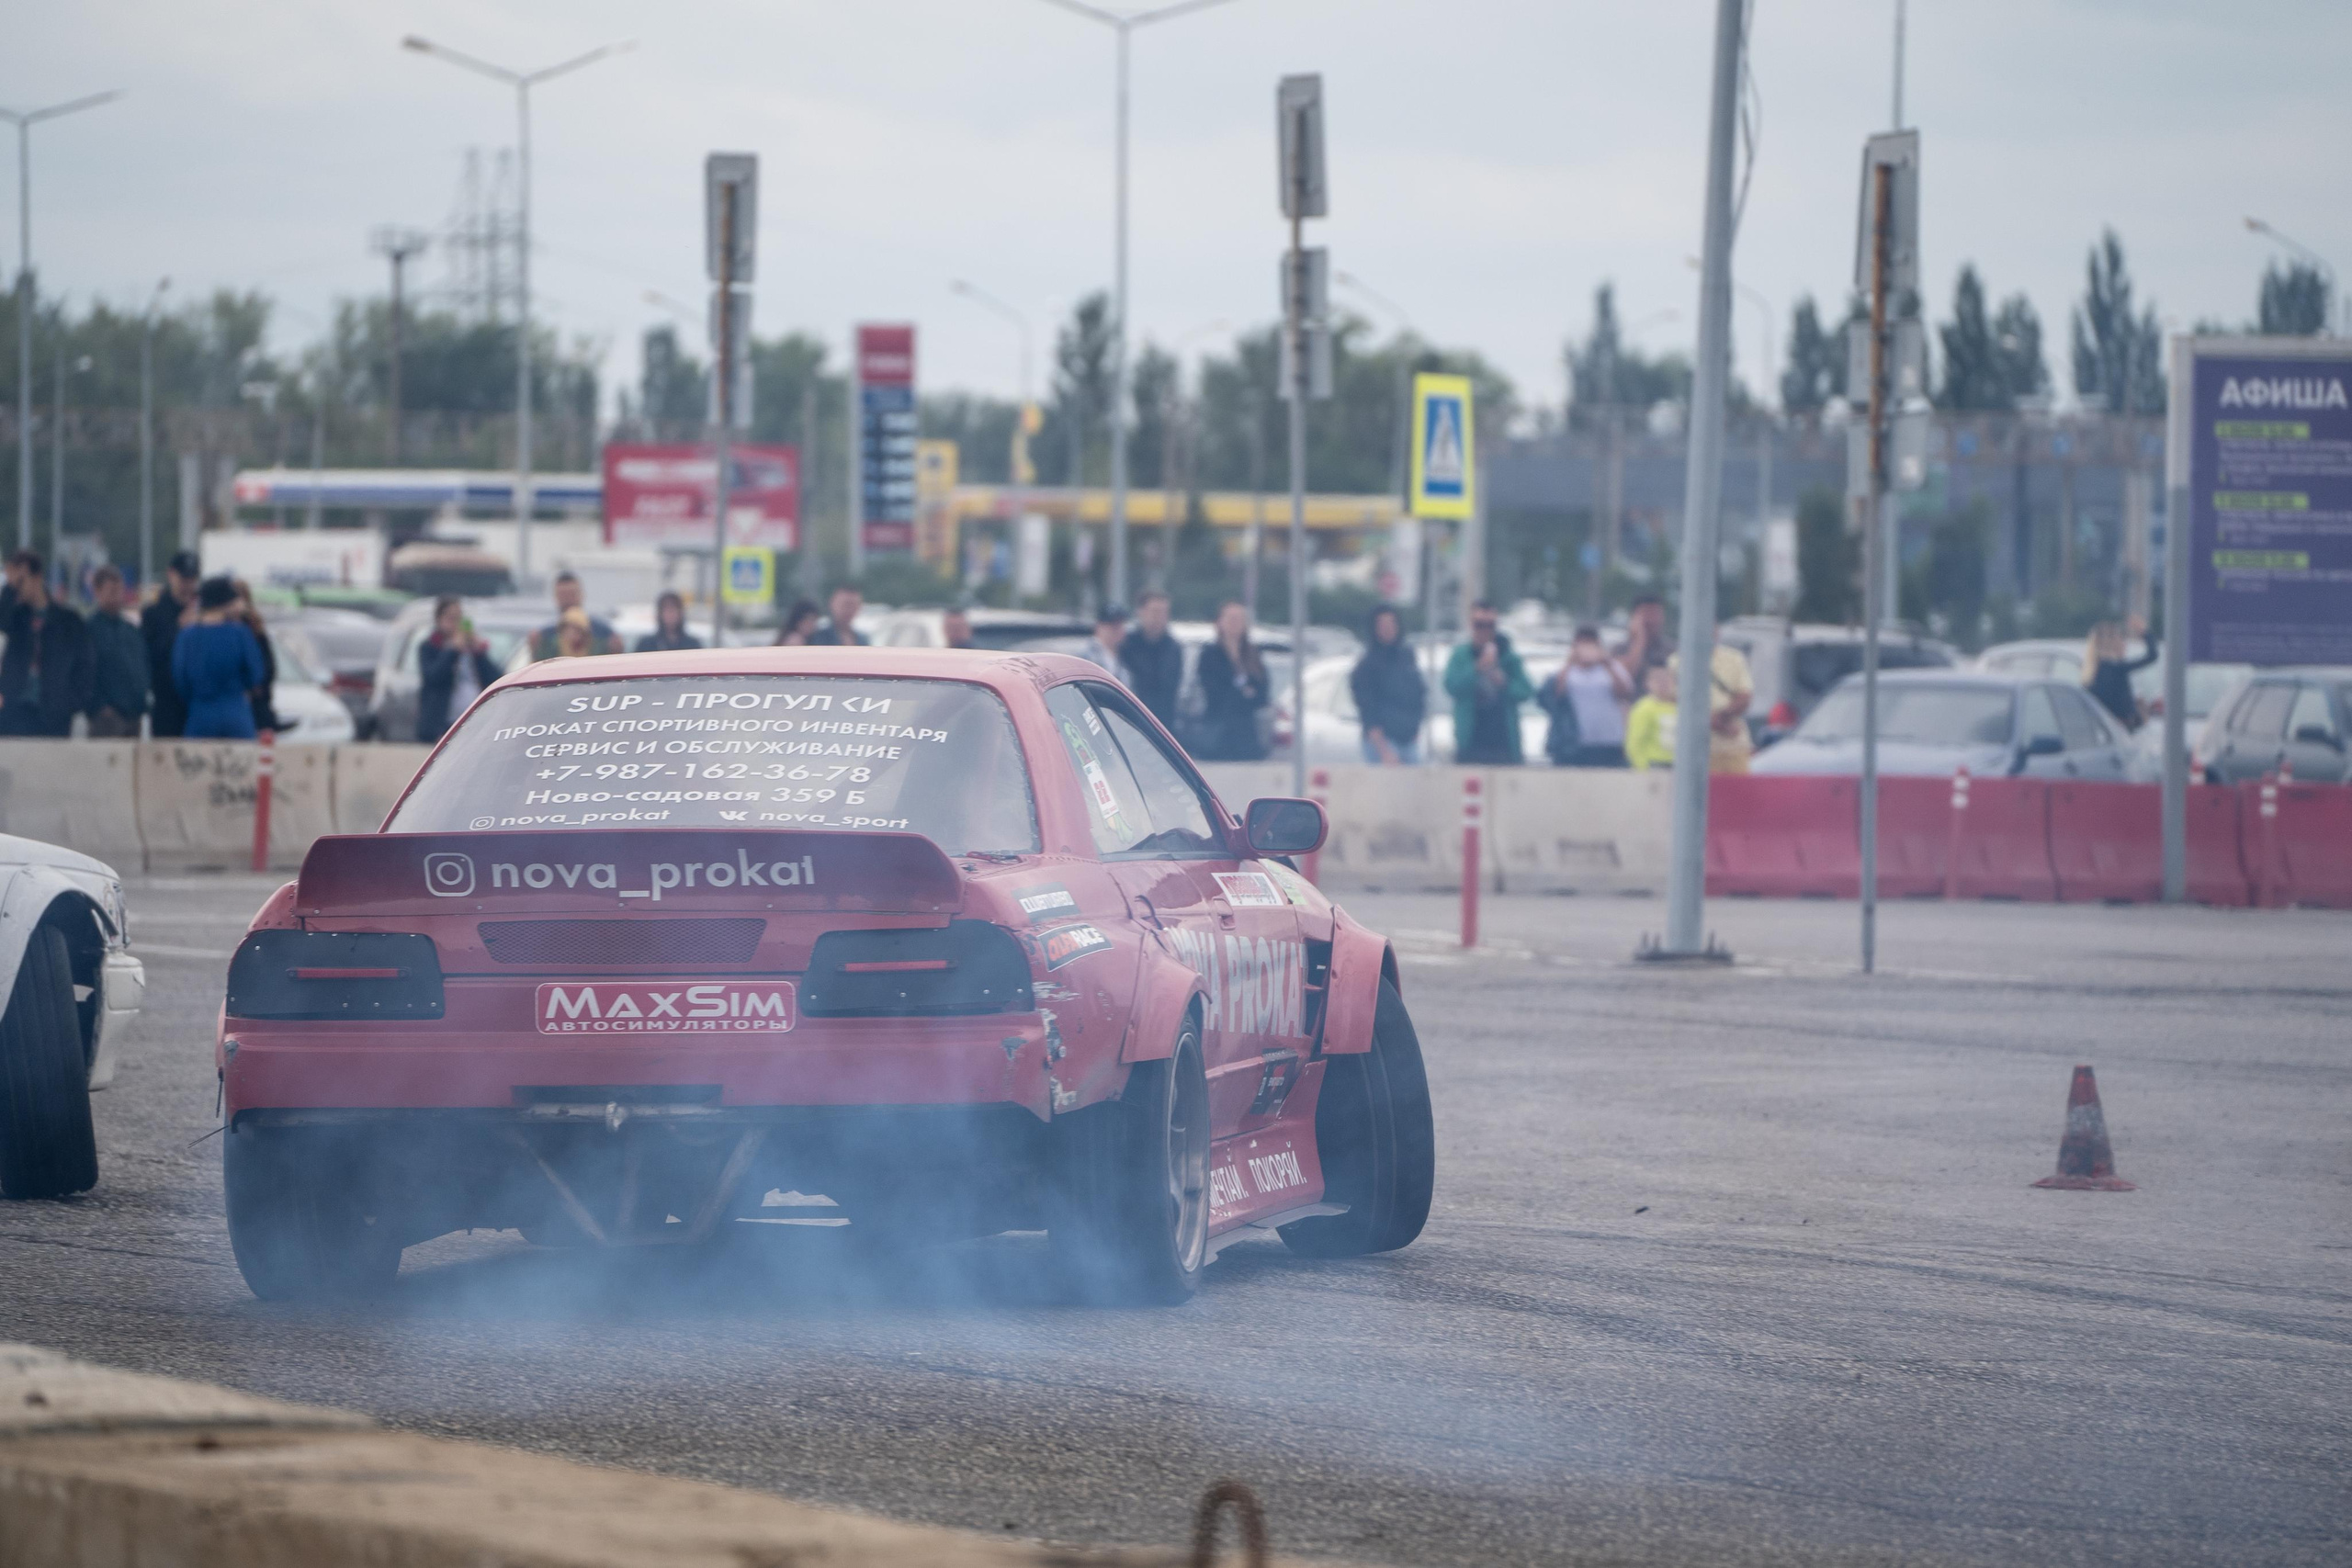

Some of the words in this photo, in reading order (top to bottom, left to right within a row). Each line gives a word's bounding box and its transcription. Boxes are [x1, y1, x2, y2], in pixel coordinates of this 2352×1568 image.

[2220, 377, 2347, 408] АФИША
[567, 695, 642, 713] SUP
[493, 721, 597, 741] ПРОКАТ
[602, 718, 793, 733] СПОРТИВНОГО
[800, 720, 948, 743] ИНВЕНТАРЯ
[526, 740, 629, 758] СЕРВИС
[636, 740, 657, 754] И
[664, 740, 901, 760] ОБСЛУЖИВАНИЕ
[536, 763, 871, 783] +7-987-162-36-78
[525, 789, 761, 805] Ново-садовая
[770, 787, 837, 804] 359
[845, 790, 865, 805] Б
[500, 807, 671, 826] nova_prokat
[759, 810, 909, 829] nova_sport
[492, 848, 816, 901] nova_prokat
[545, 1019, 787, 1032] АВТОСИМУЛЯТОРЫ
